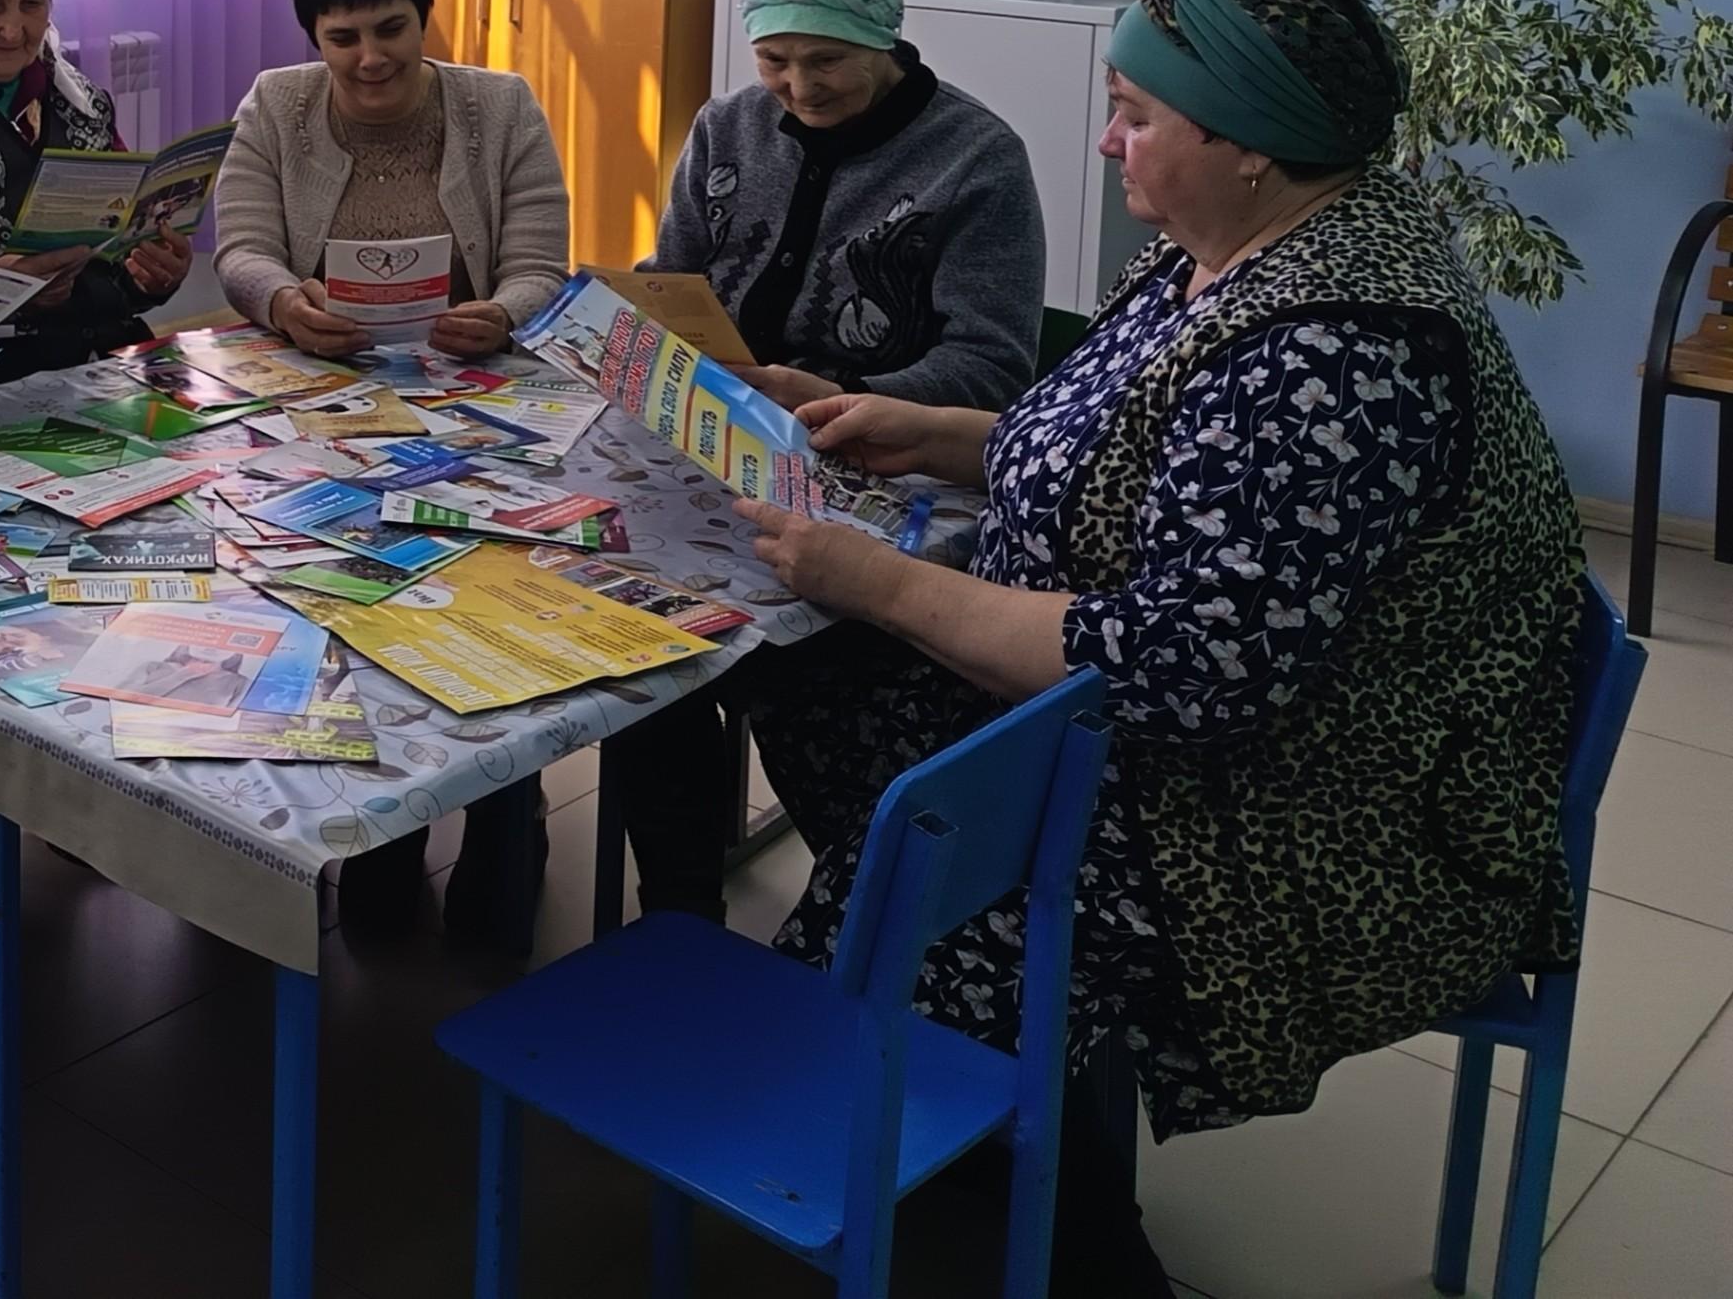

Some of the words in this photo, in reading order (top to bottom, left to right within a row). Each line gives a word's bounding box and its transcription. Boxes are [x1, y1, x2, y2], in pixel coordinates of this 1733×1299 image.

[610, 310, 636, 359] ОДНОГО
[635, 325, 661, 364] ГТО!
[667, 343, 695, 384] силу
[658, 413, 680, 441] верь
[698, 410, 718, 463] ловкость
[101, 553, 209, 565] НАРКОТИКАХ
